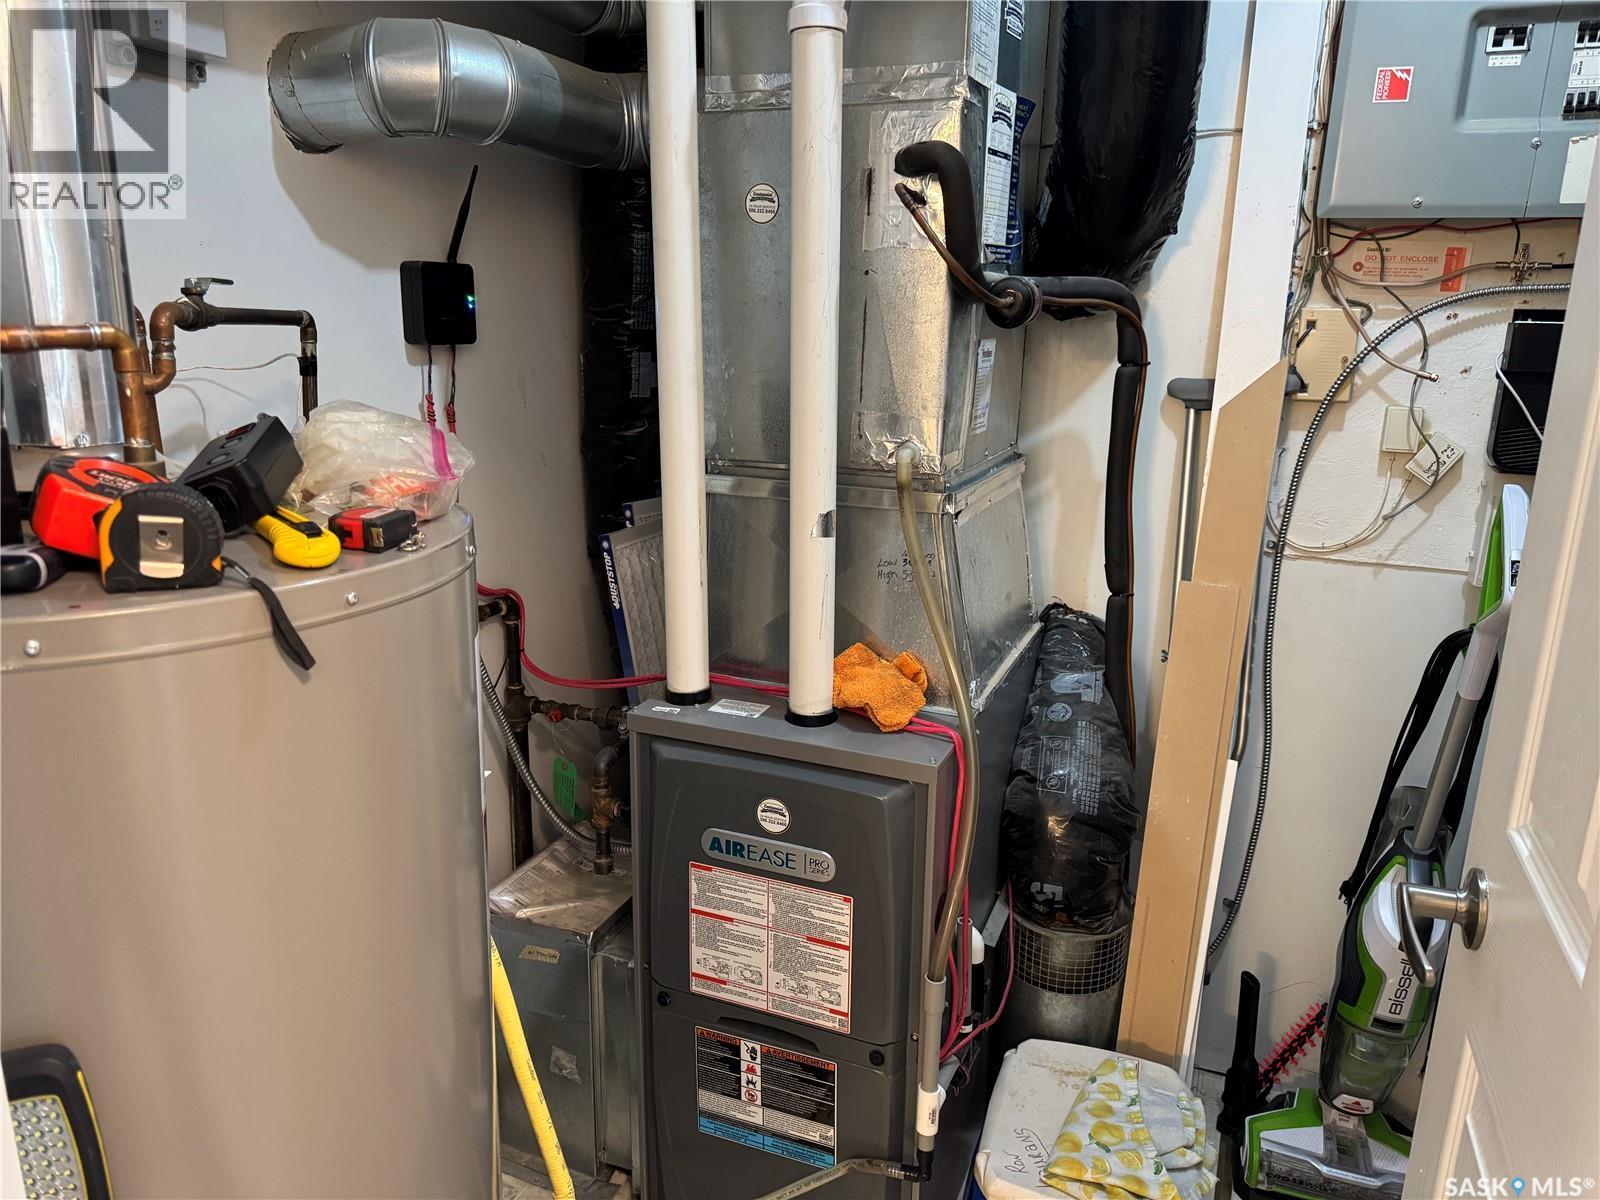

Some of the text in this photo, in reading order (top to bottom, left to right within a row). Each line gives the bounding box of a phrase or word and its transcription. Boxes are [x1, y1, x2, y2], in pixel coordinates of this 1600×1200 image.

[1375, 69, 1385, 99] FEDERAL
[1382, 70, 1391, 99] PIONEER
[603, 551, 619, 606] DUSTSTOP
[877, 569, 899, 584] High
[709, 836, 797, 870] AIREASE
[809, 857, 830, 870] PRO
[808, 868, 830, 877] SERIES
[706, 1031, 738, 1044] WARNING
[772, 1048, 829, 1069] AVERTISSEMENT
